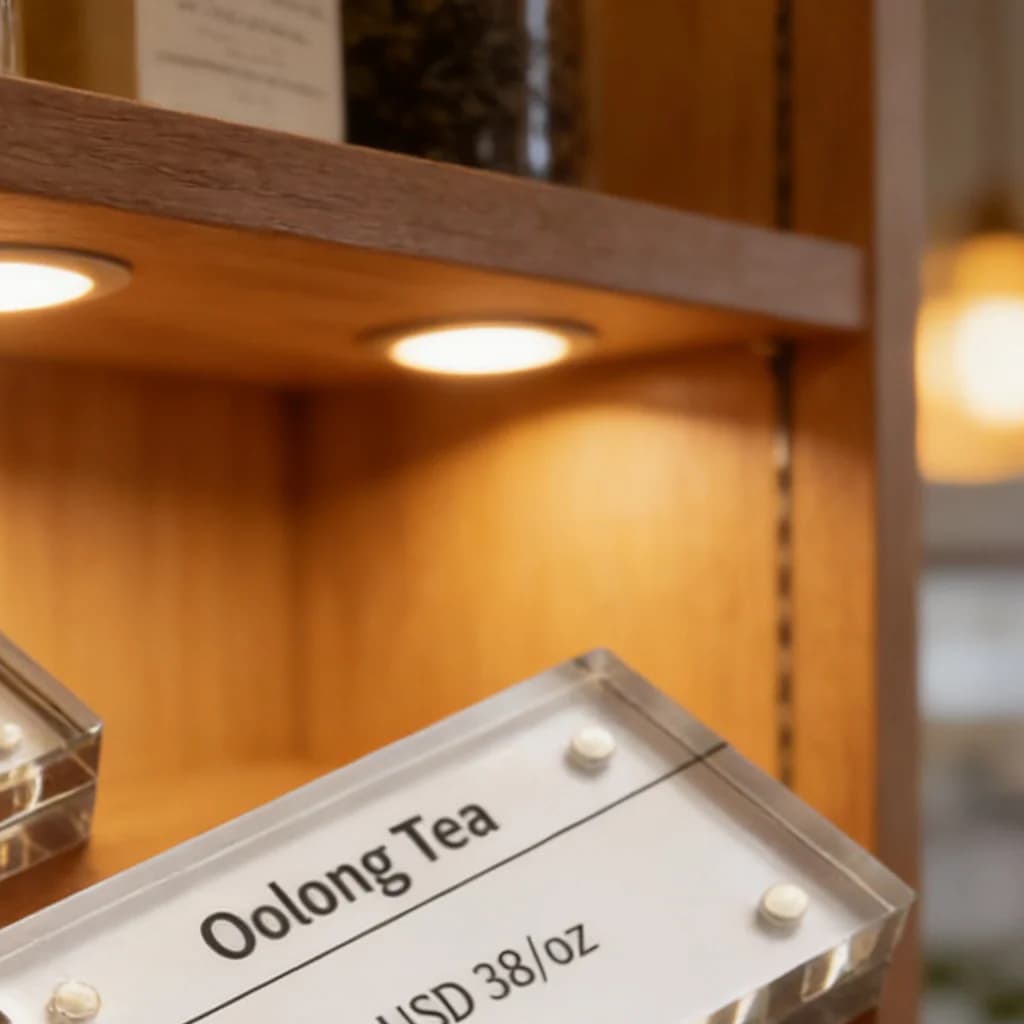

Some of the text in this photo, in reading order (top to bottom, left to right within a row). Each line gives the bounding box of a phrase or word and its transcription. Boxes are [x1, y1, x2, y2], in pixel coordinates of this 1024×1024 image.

[199, 803, 500, 961] Oolong Tea
[471, 923, 600, 1001] 38/oz
